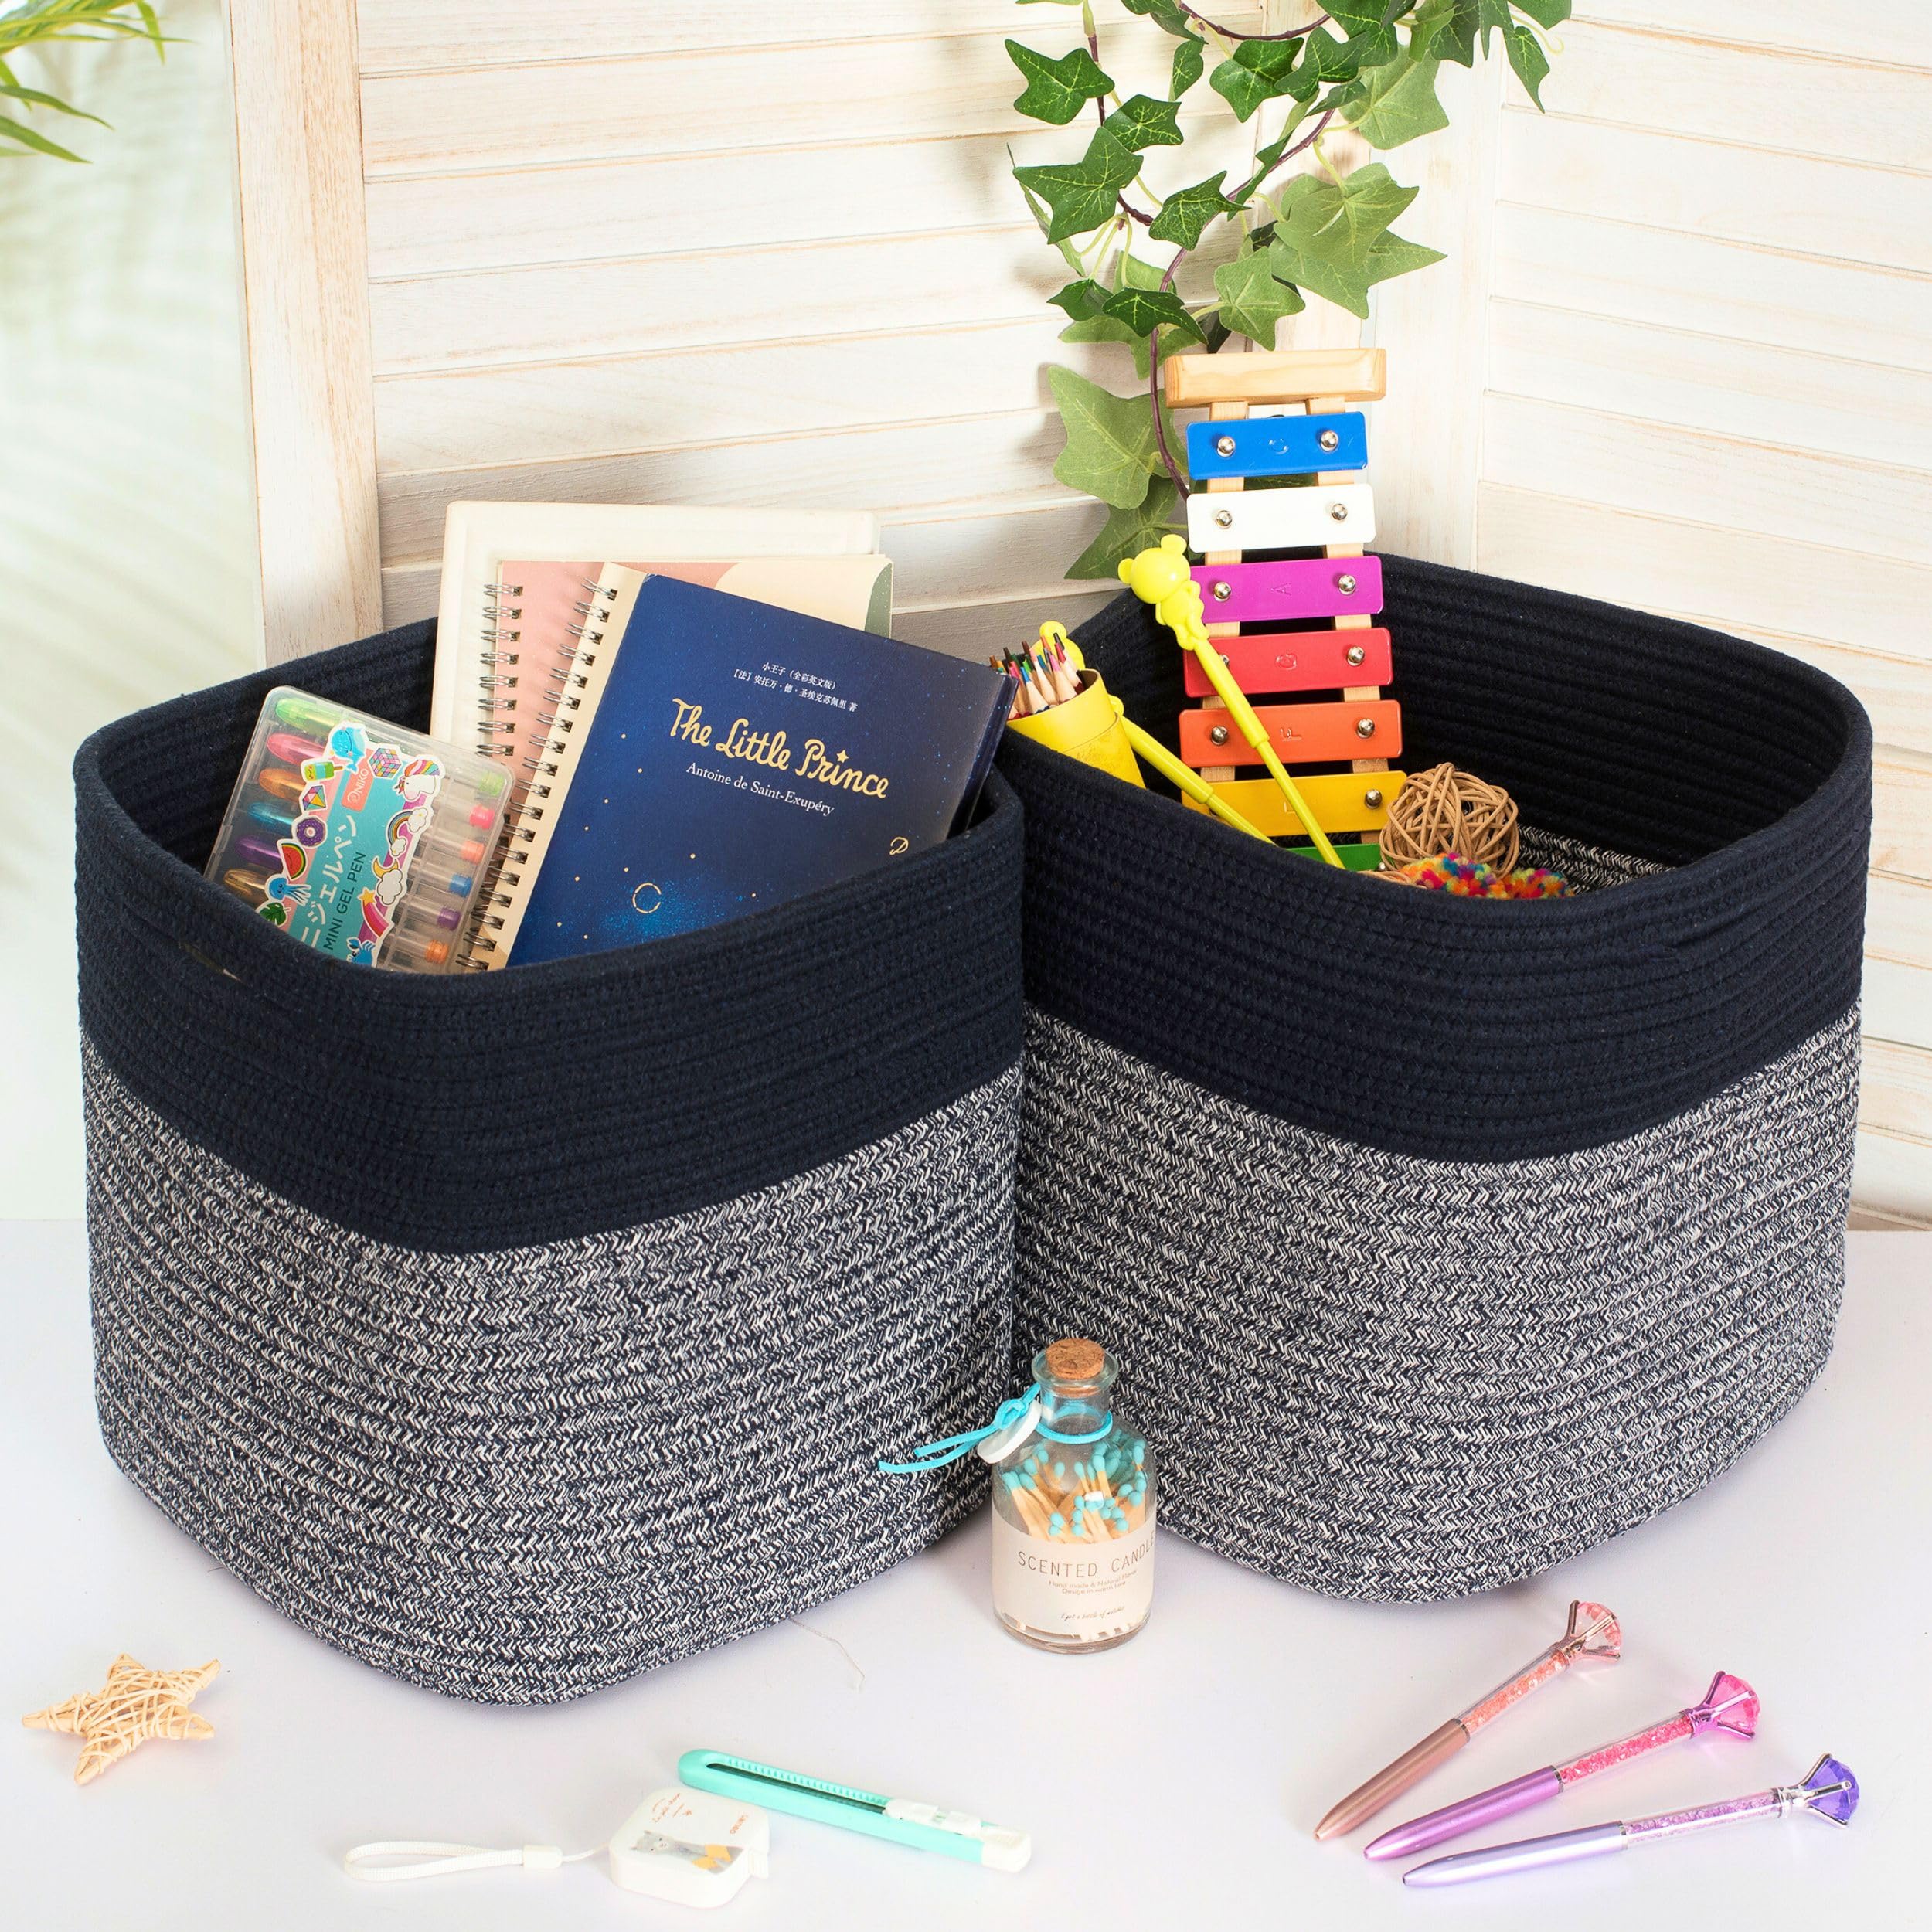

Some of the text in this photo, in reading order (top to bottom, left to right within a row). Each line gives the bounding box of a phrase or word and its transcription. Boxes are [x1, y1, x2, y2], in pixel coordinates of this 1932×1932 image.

[669, 698, 889, 799] The Little Prince
[685, 762, 835, 816] Antoine de Saint-Exupéry
[323, 852, 367, 951] MINI GEL PEN
[1018, 1550, 1097, 1578] SCENTED
